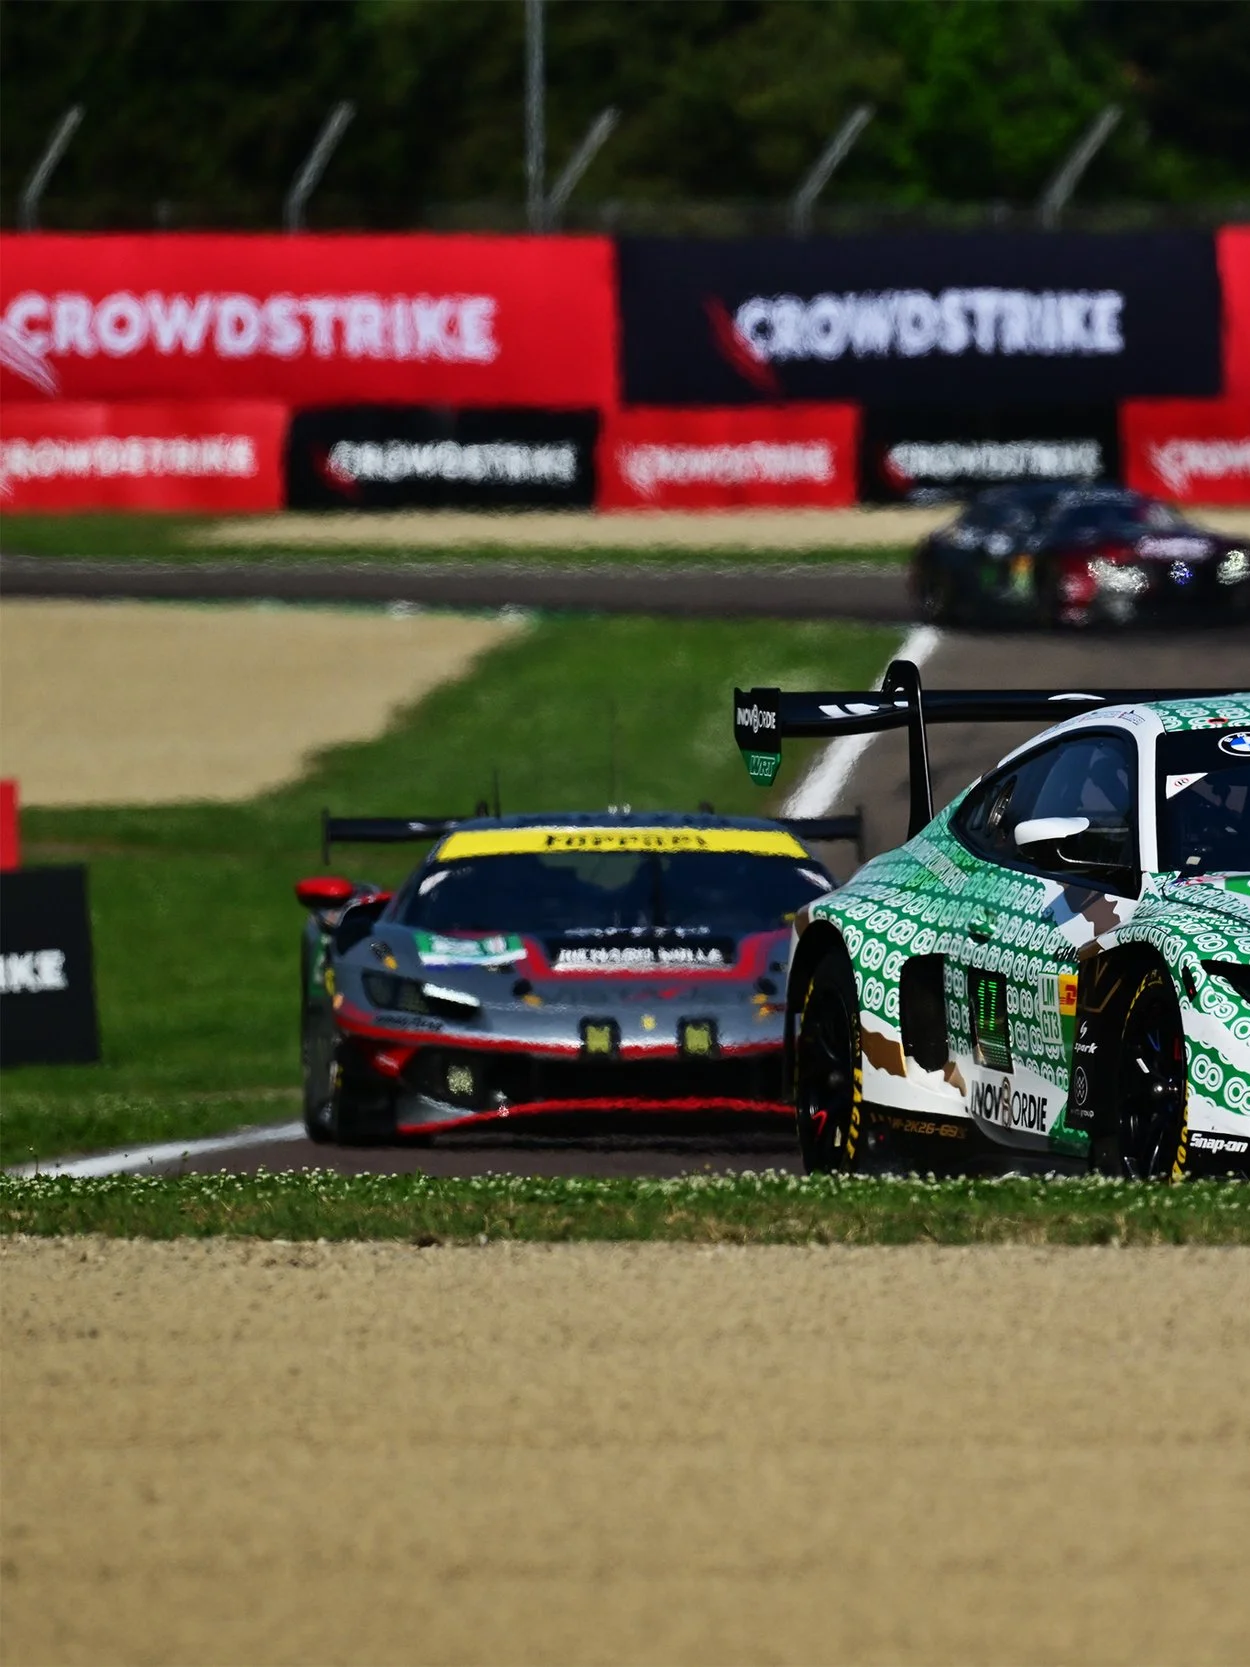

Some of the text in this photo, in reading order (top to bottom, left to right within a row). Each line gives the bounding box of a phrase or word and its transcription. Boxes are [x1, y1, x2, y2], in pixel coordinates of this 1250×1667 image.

[5, 290, 497, 363] CROWDSTRIKE
[734, 287, 1124, 360] CROWDSTRIKE
[750, 755, 775, 777] WRT
[1042, 1009, 1060, 1040] GT3
[1074, 1042, 1098, 1053] spark
[1190, 1133, 1248, 1154] Snap-on
